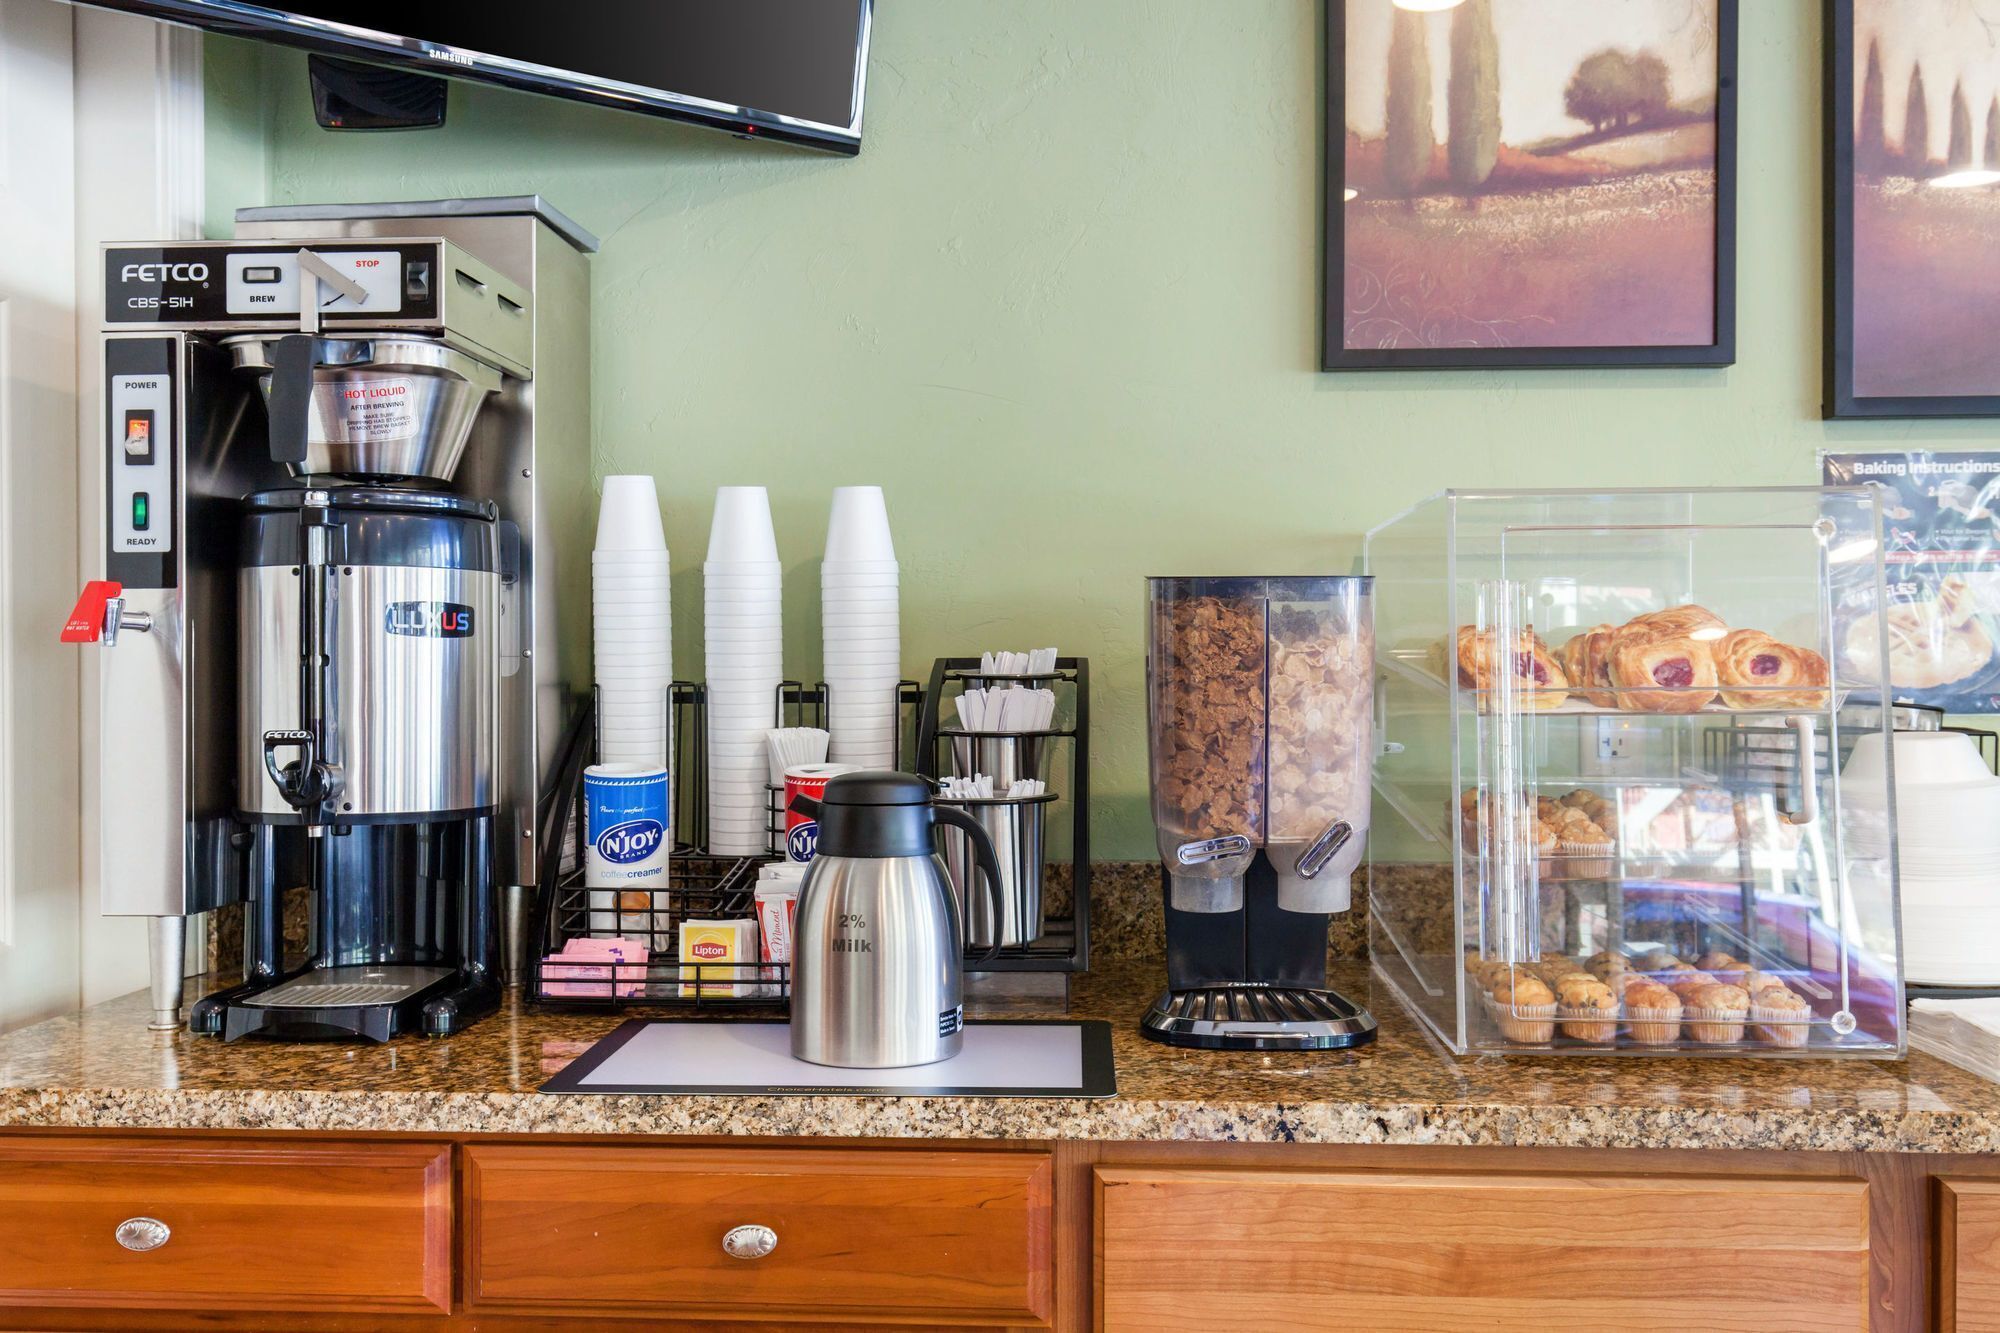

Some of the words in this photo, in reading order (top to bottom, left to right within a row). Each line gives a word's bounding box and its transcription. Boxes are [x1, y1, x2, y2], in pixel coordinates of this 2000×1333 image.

[429, 49, 473, 66] SAMSUNG
[355, 259, 380, 268] STOP
[121, 263, 209, 282] FETCO
[249, 295, 276, 303] BREW
[125, 381, 158, 389] POWER
[344, 389, 367, 399] HOT
[369, 386, 406, 398] LIQUID
[350, 403, 372, 411] AFTER
[373, 400, 405, 410] BREWING
[1853, 460, 1907, 477] Baking
[1908, 459, 2000, 474] Instructions
[126, 538, 157, 546] READY
[266, 730, 307, 739] FETCO
[620, 850, 647, 860] BRAND
[839, 914, 866, 929] 2%
[695, 945, 724, 956] Lipton
[832, 939, 872, 953] Milk
